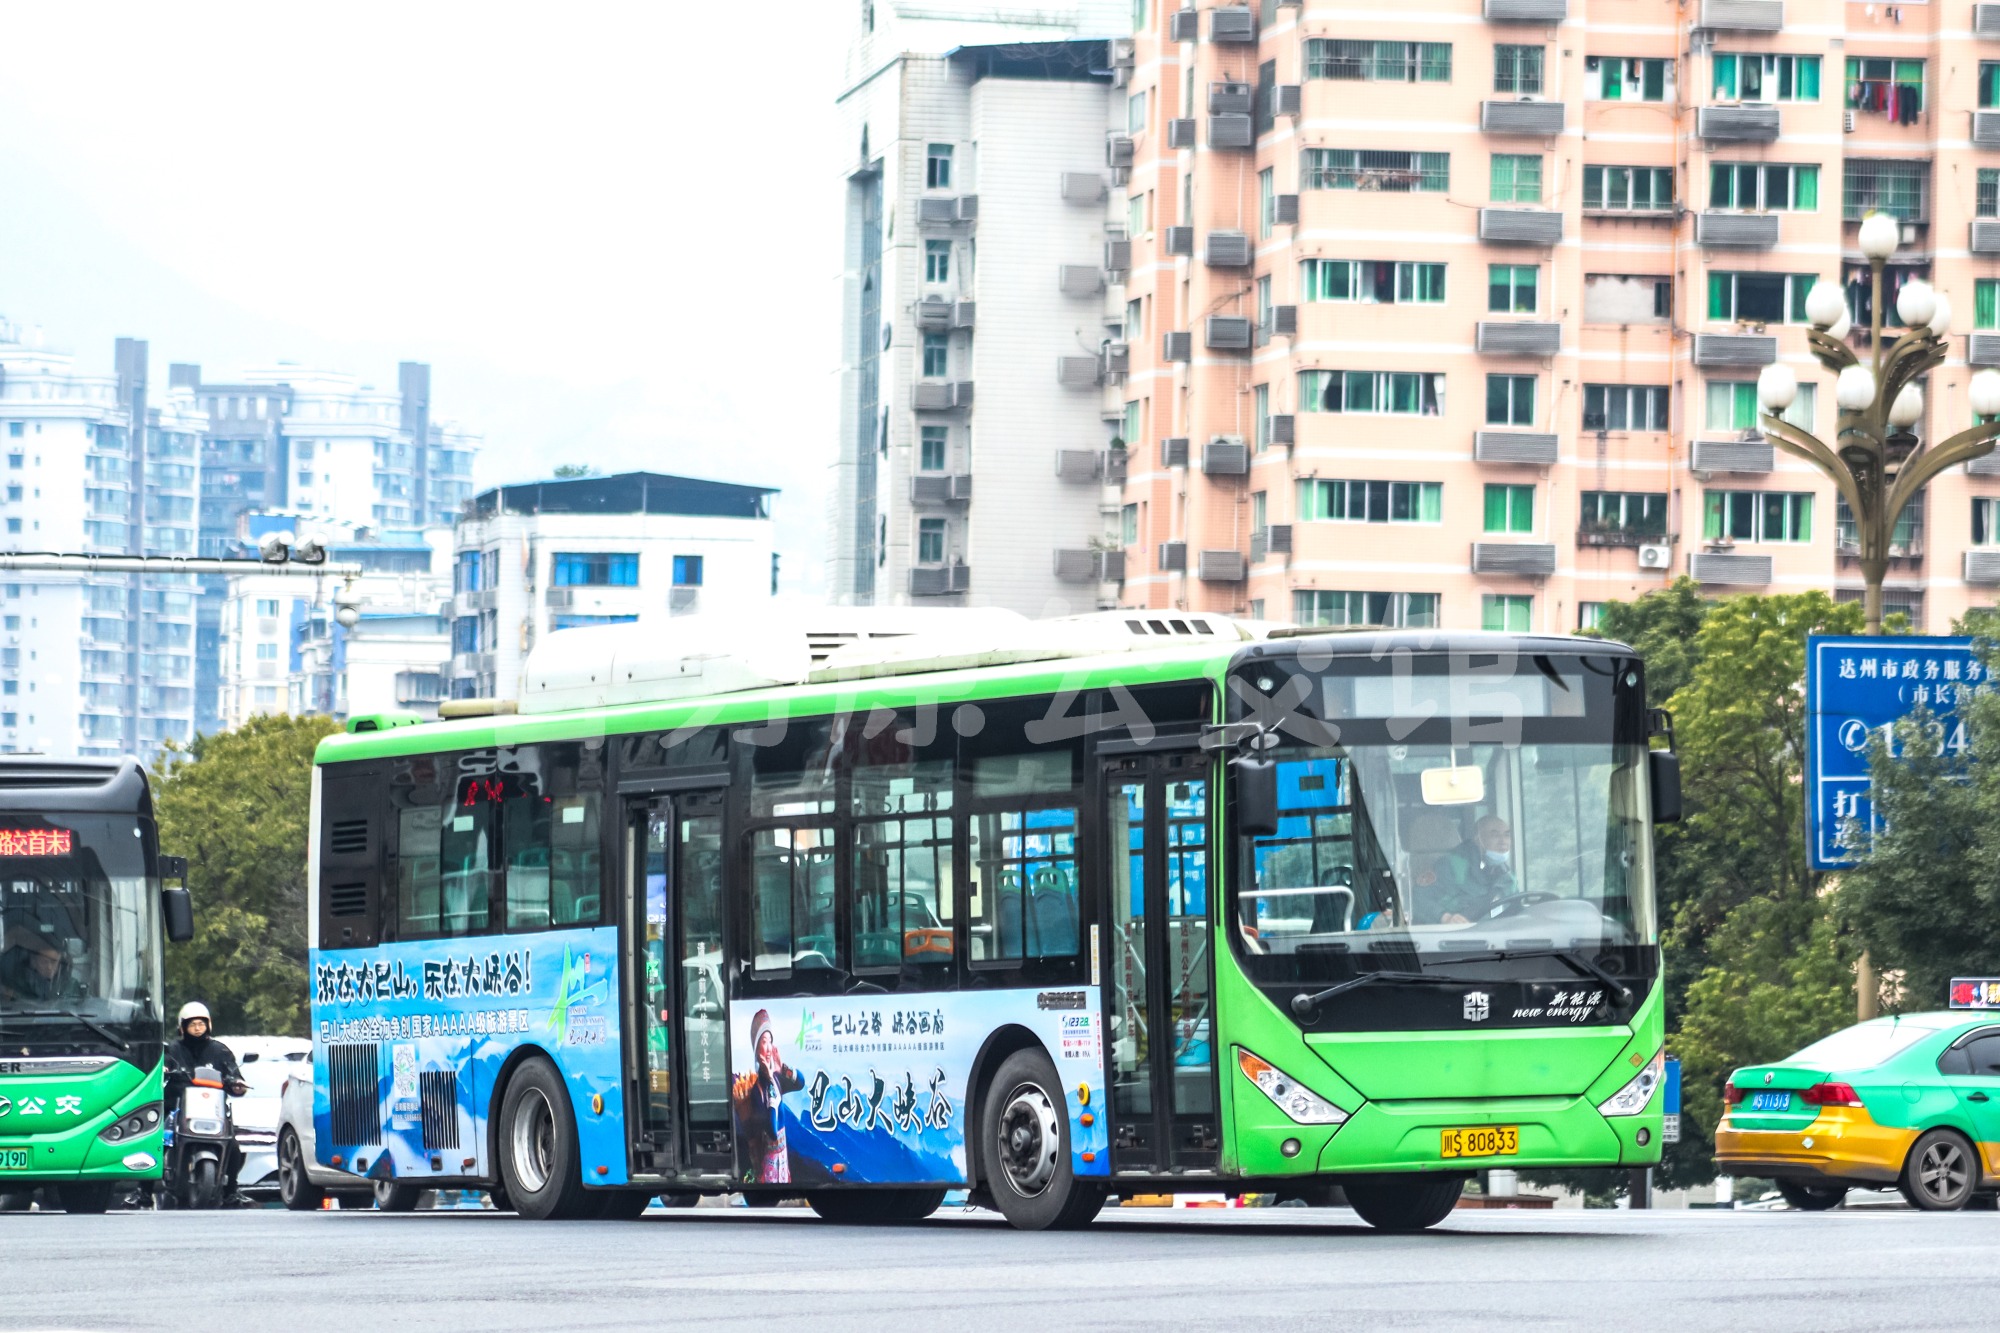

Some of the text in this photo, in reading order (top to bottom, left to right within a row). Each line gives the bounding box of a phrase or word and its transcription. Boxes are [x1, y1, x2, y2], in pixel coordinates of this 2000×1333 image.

[1838, 657, 1996, 681] 达州市政务服务
[1549, 989, 1604, 1007] 新能源
[319, 1008, 530, 1043] 巴山大峡谷全力争创国家AAAAA级旅游景区
[1512, 1006, 1595, 1022] new energy
[17, 1094, 83, 1116] 公交
[807, 1066, 954, 1136] 巴山大峡谷
